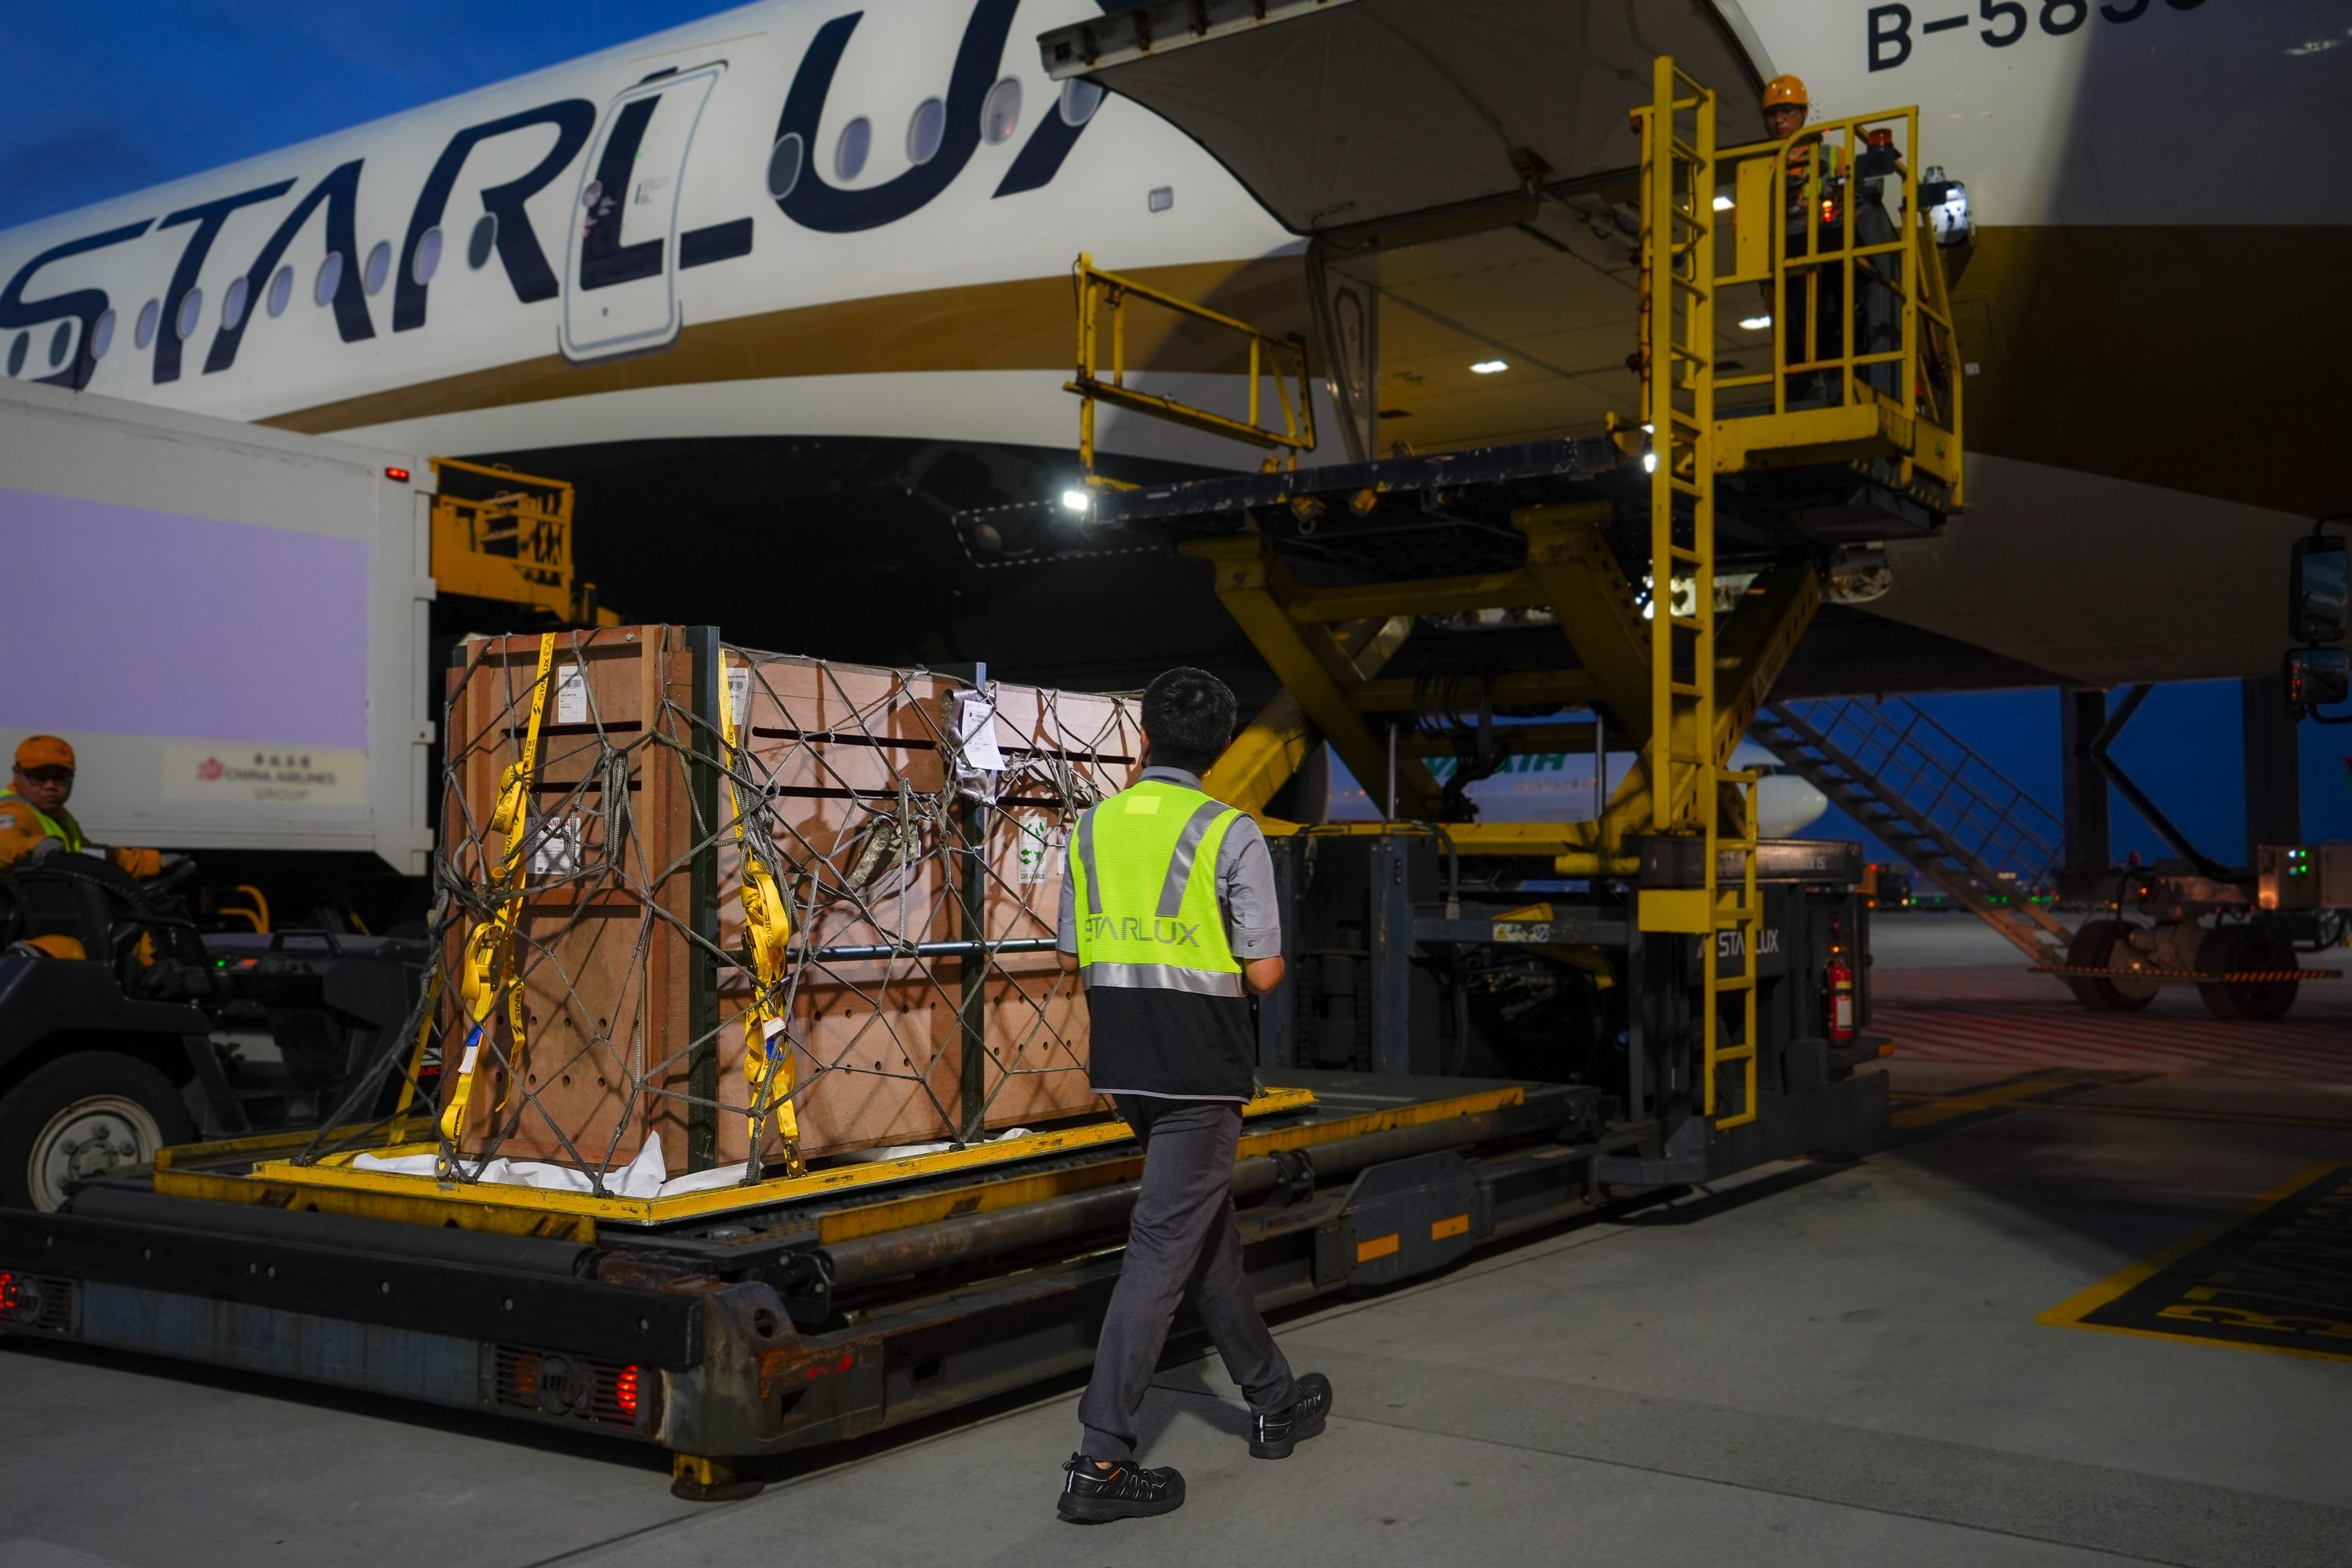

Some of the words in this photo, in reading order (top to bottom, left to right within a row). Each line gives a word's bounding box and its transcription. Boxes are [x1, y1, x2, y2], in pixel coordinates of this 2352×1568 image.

[1868, 0, 2208, 72] B-58
[538, 659, 550, 700] STAUX
[1718, 929, 1779, 957] STAUX
